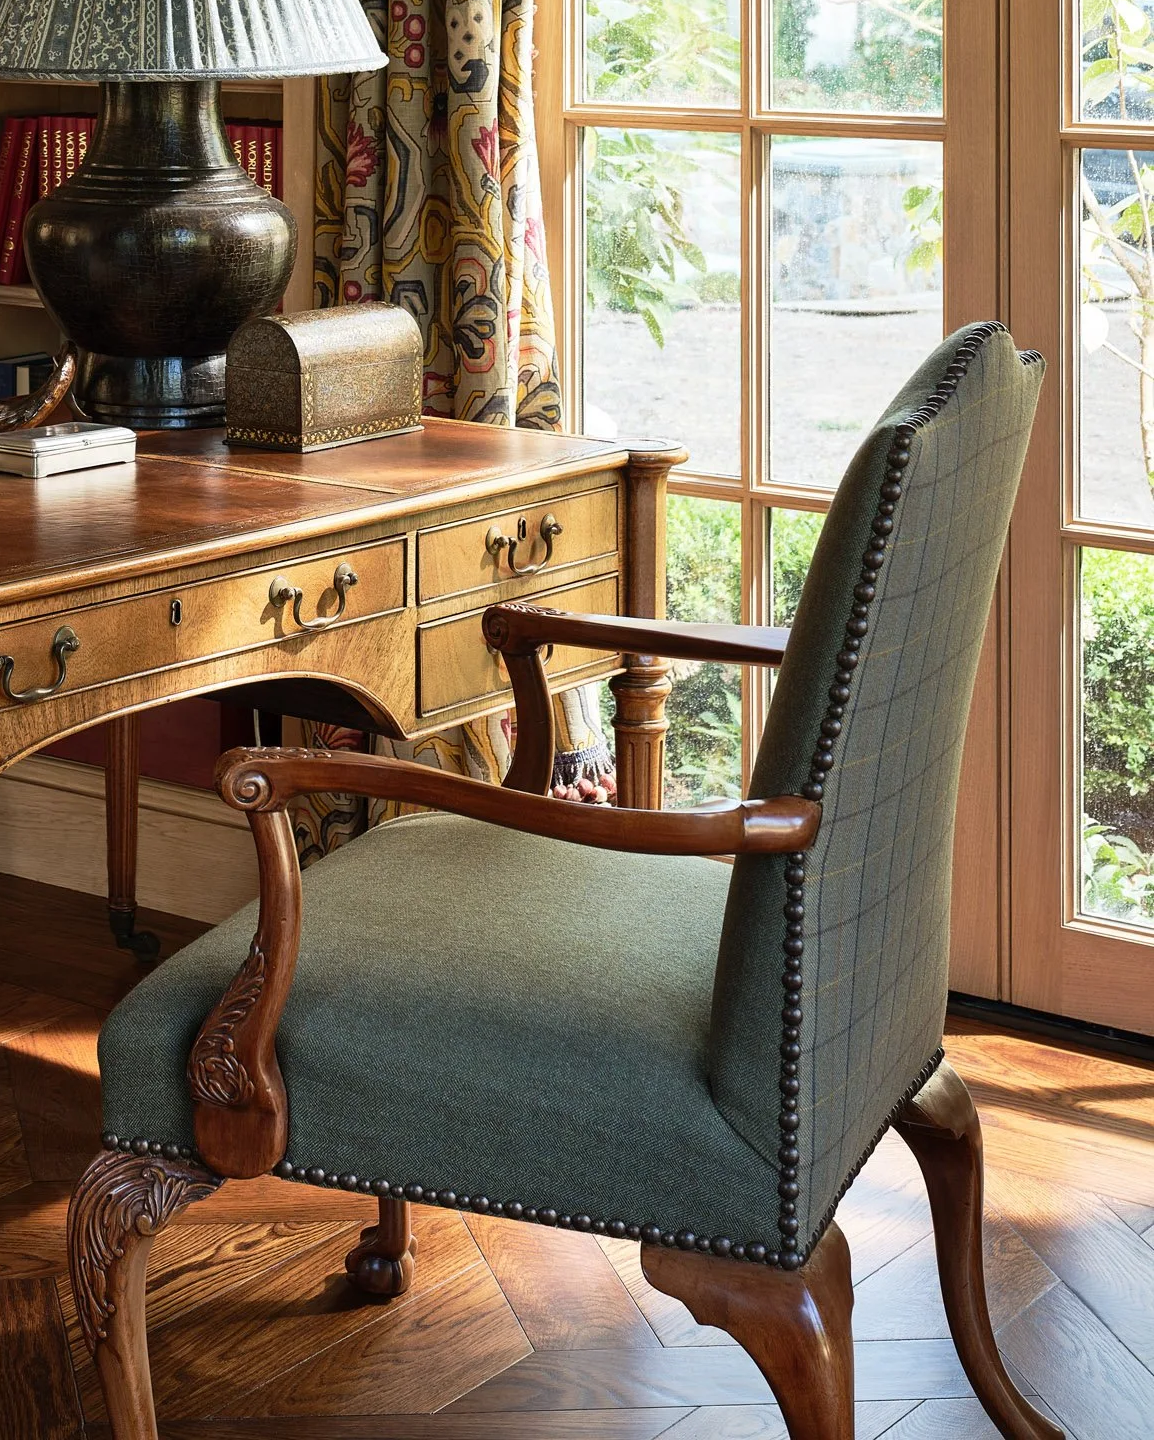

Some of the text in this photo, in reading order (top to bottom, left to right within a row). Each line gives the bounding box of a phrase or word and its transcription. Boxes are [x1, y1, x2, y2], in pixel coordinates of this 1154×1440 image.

[16, 131, 32, 199] WORLD BOOK
[40, 130, 48, 198] WORLD BOOK
[54, 130, 62, 188] WORLD BO
[66, 131, 75, 170] WORLD
[78, 131, 87, 165] WOR
[248, 140, 257, 181] WORLD
[264, 142, 272, 182] WORLD
